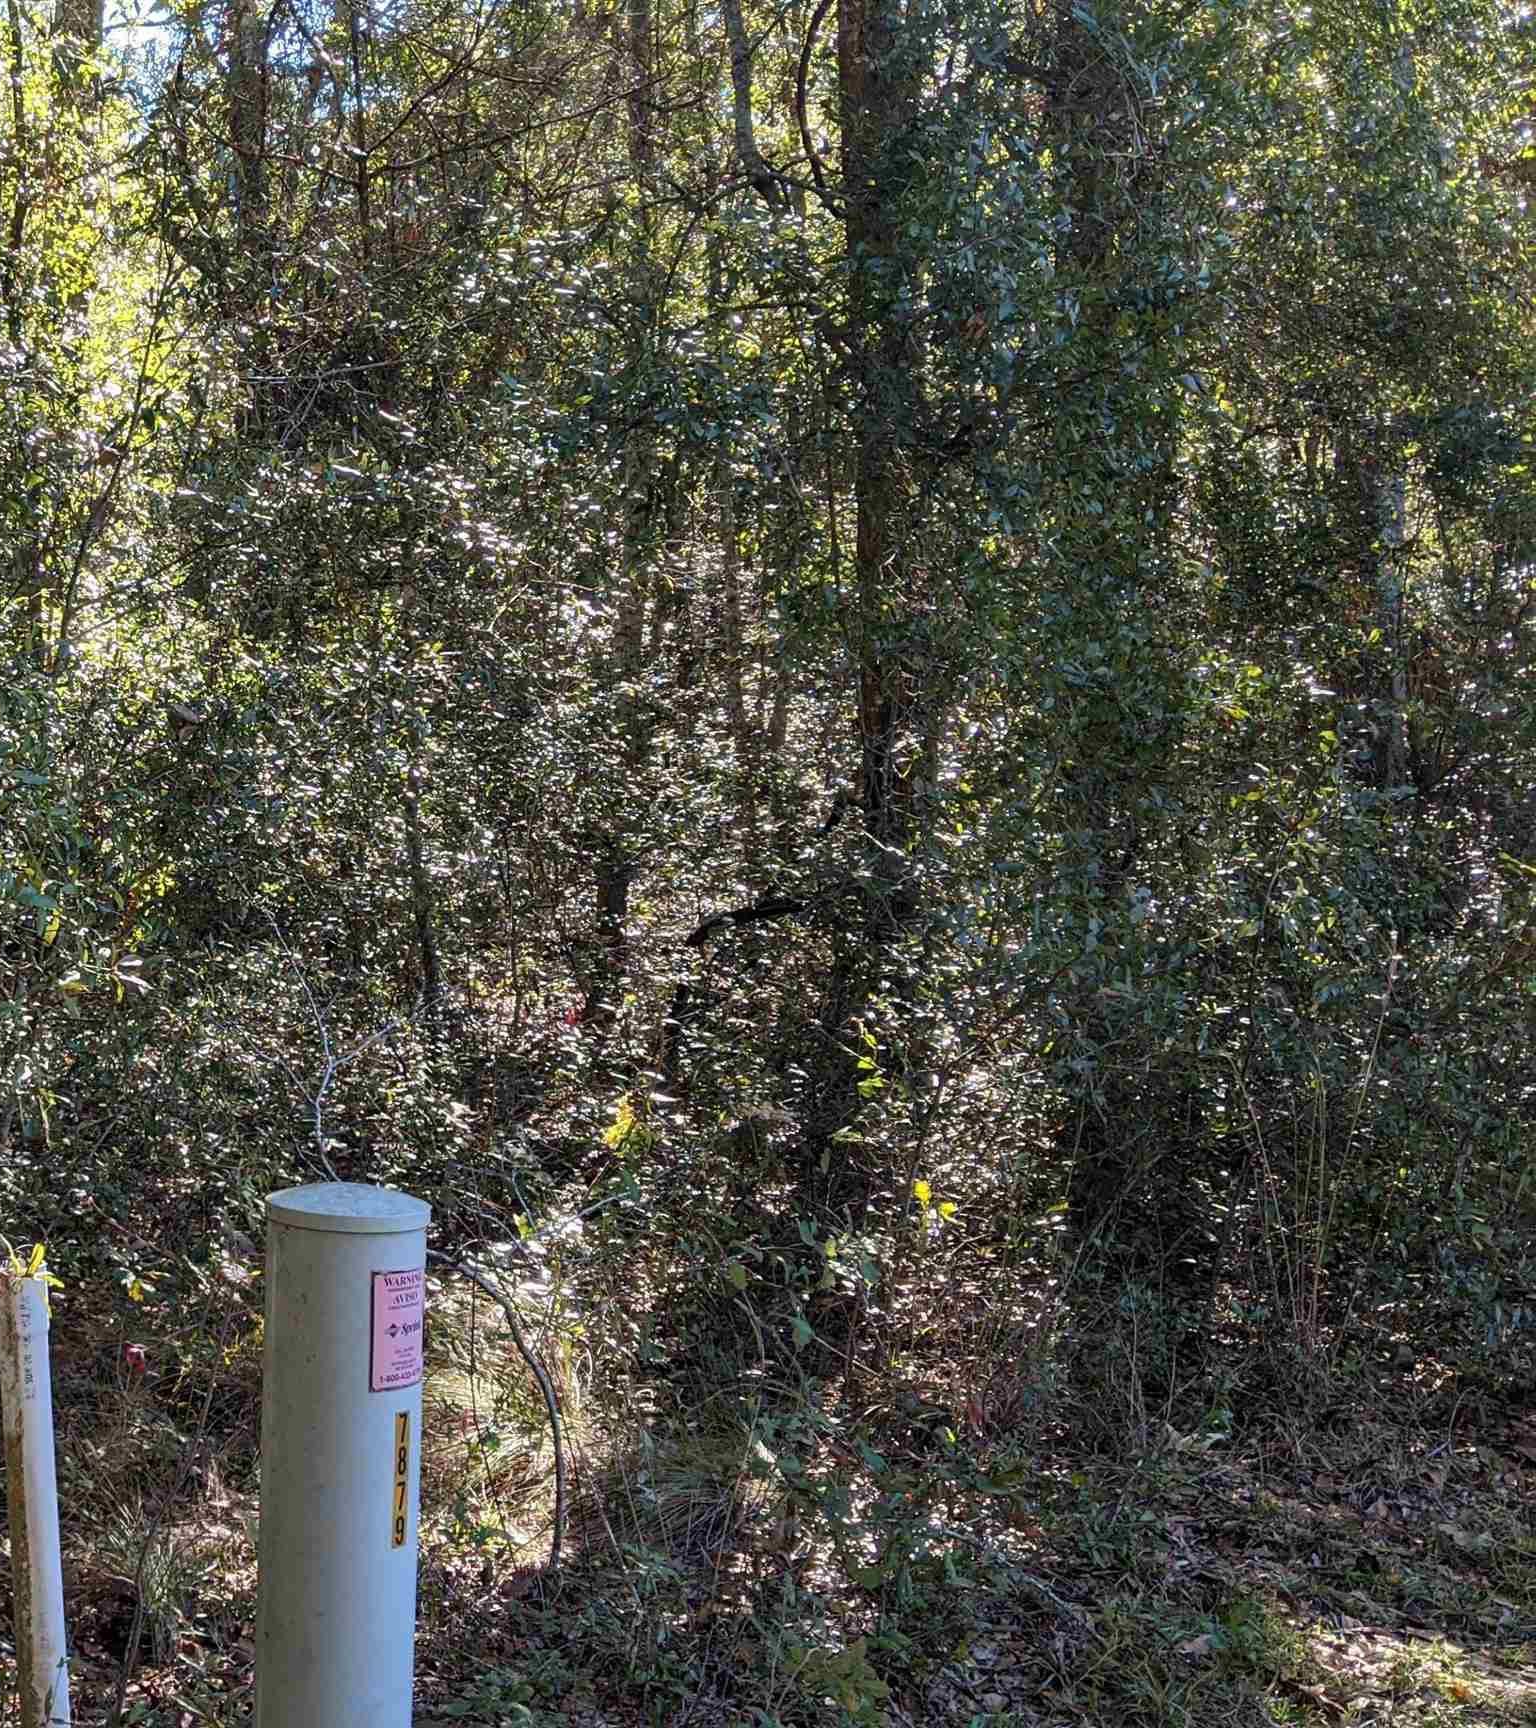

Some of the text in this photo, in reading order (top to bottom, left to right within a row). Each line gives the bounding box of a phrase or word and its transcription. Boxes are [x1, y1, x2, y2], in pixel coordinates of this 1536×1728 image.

[384, 1272, 421, 1288] WARNIN
[400, 1320, 421, 1337] Sprin
[394, 1412, 407, 1545] 7879
